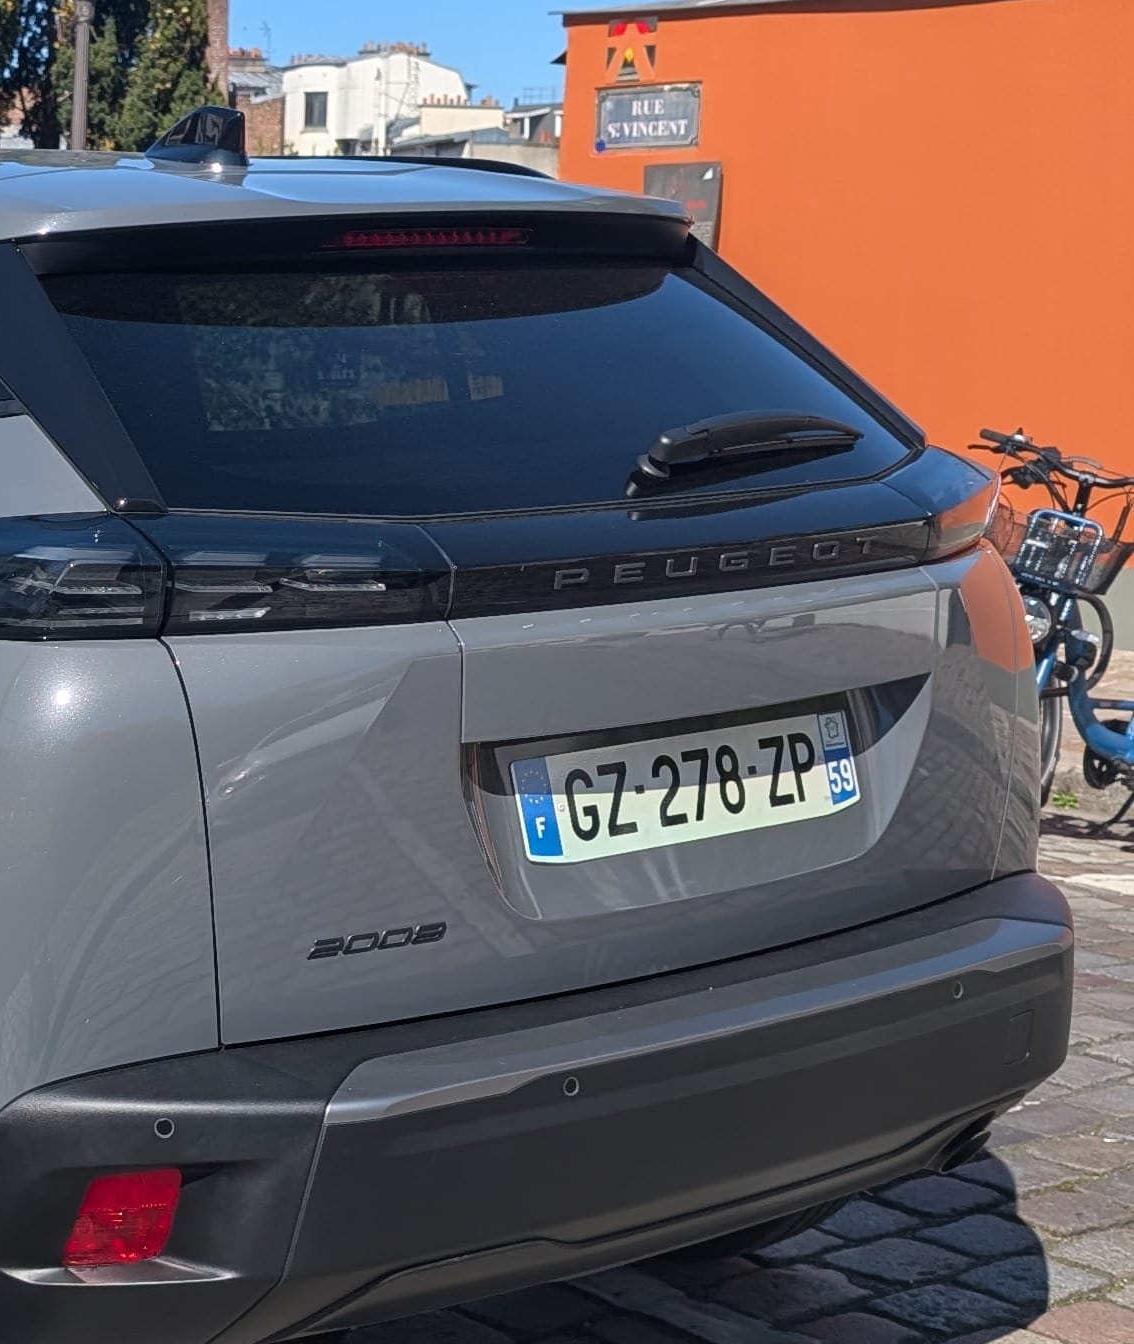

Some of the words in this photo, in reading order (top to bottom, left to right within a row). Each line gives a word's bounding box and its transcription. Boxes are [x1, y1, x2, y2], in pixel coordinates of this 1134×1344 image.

[631, 98, 665, 116] RUE
[622, 118, 688, 137] VINCENT
[553, 536, 878, 590] PEUGEOT
[565, 732, 815, 841] GZ-278-ZP
[828, 758, 854, 794] 59
[535, 816, 546, 839] F
[306, 921, 447, 960] 2008
